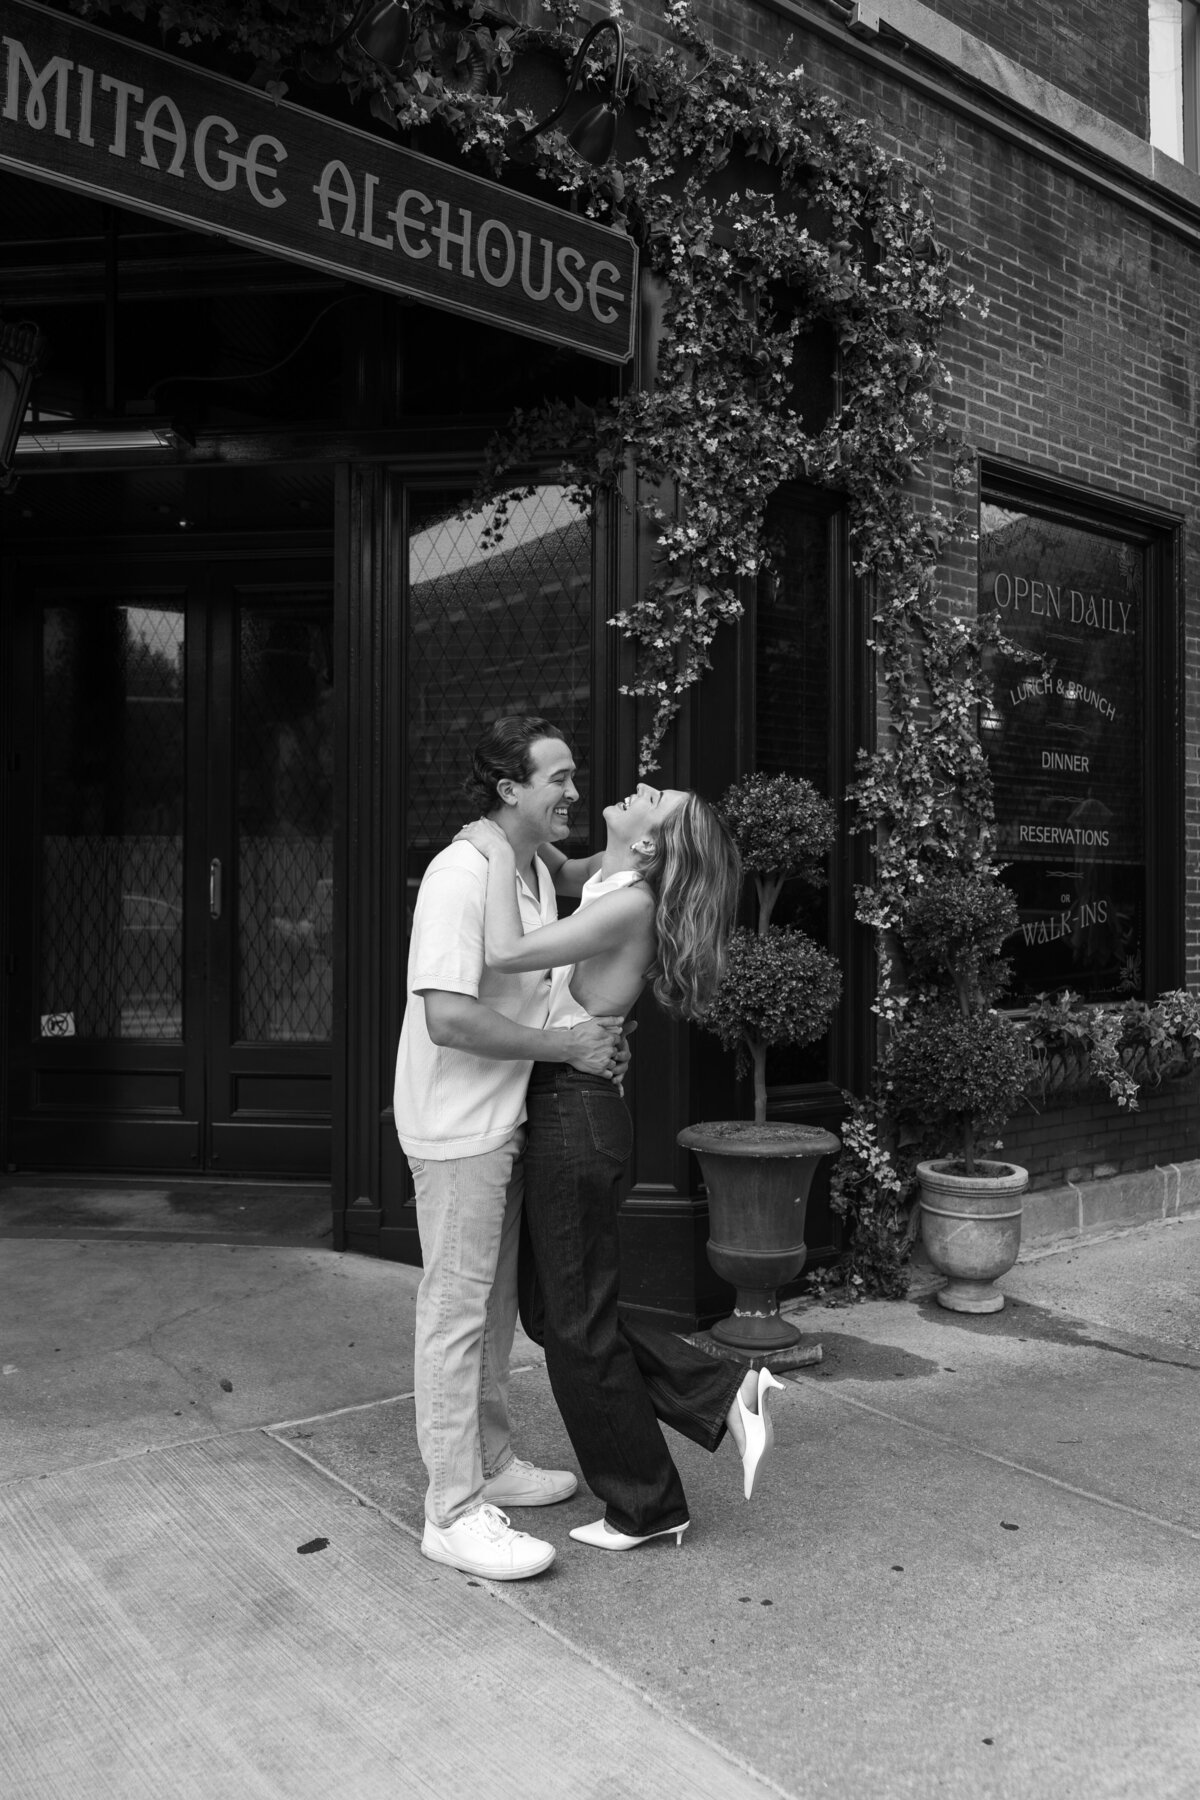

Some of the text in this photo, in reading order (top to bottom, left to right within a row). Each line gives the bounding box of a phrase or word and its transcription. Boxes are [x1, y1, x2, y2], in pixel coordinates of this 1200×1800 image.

[1, 35, 625, 324] MITAGE ALEHOUSE
[994, 573, 1061, 619] OPEN
[1010, 678, 1117, 721] LUNCH & BRUNCH
[1041, 751, 1090, 773] DINNER
[1019, 825, 1110, 847] RESERVATIONS
[1060, 894, 1071, 903] OR
[1021, 900, 1108, 947] WALK-INS
